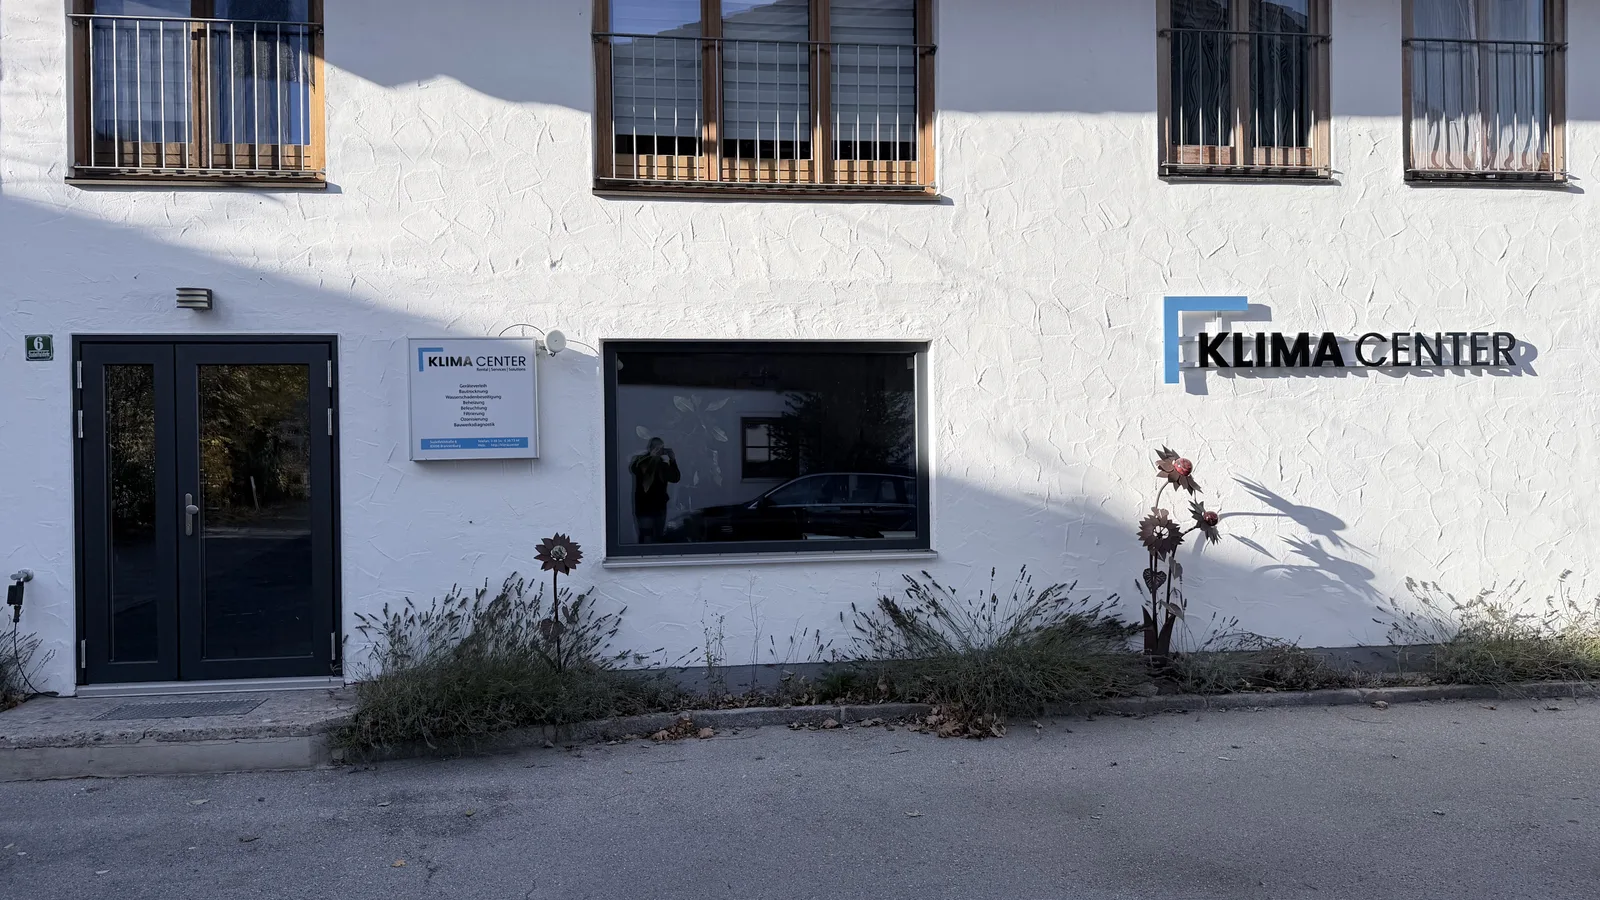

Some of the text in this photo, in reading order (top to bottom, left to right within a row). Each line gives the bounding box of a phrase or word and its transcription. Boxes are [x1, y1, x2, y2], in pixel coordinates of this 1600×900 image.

[34, 336, 44, 351] 6
[1199, 332, 1517, 368] KLIMA CENTER
[428, 356, 526, 366] KLIMA CENTER
